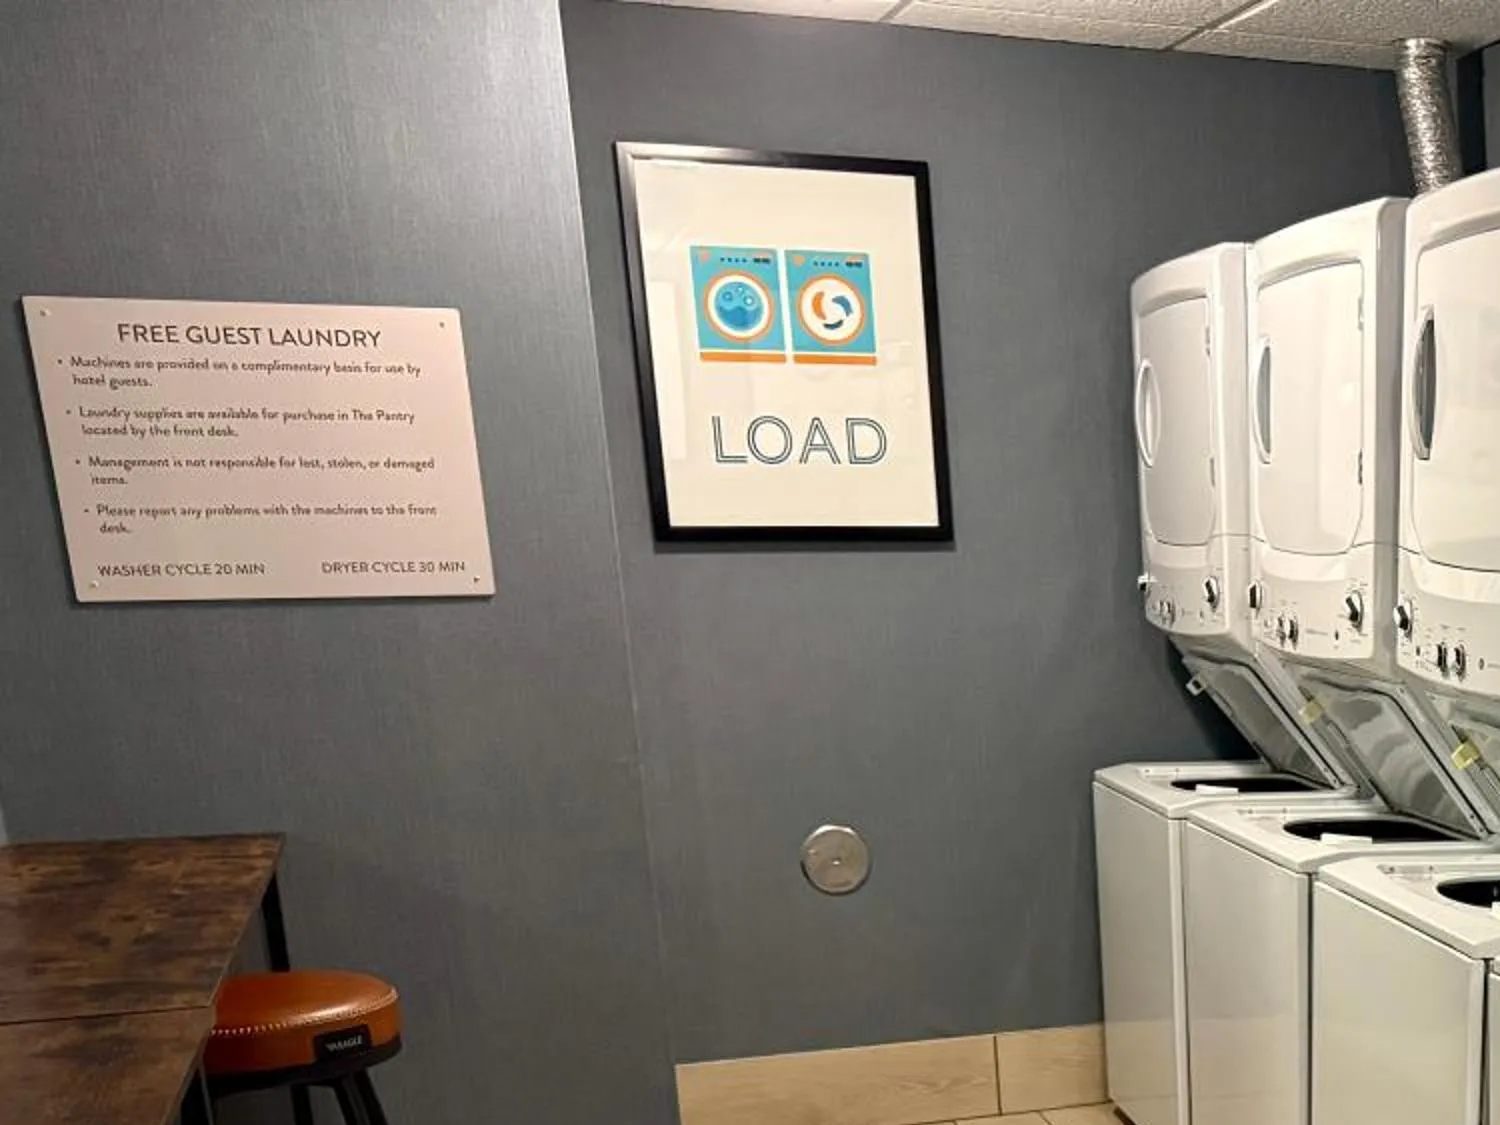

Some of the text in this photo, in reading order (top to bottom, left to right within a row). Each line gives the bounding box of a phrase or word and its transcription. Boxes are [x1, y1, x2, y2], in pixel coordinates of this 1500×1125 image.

[117, 323, 381, 347] FREE GUEST LAUNDRY
[70, 356, 421, 378] Machines are provided on a complimentary basis for use by
[73, 374, 153, 390] hotel guests.
[79, 406, 415, 425] Laundry supplies are available for purchase in The Pantry
[82, 424, 239, 439] located by the front desk.
[711, 415, 888, 465] LOAD
[88, 456, 435, 472] Management is not responsible for lost, stolen, or damaged
[91, 475, 128, 485] items.
[96, 503, 437, 520] Please report any problems with the machines to the front
[99, 522, 133, 534] desk.
[97, 563, 265, 577] WASHER CYCLE 20 MIN
[321, 560, 465, 574] DRYER CYCLE 30 MIN
